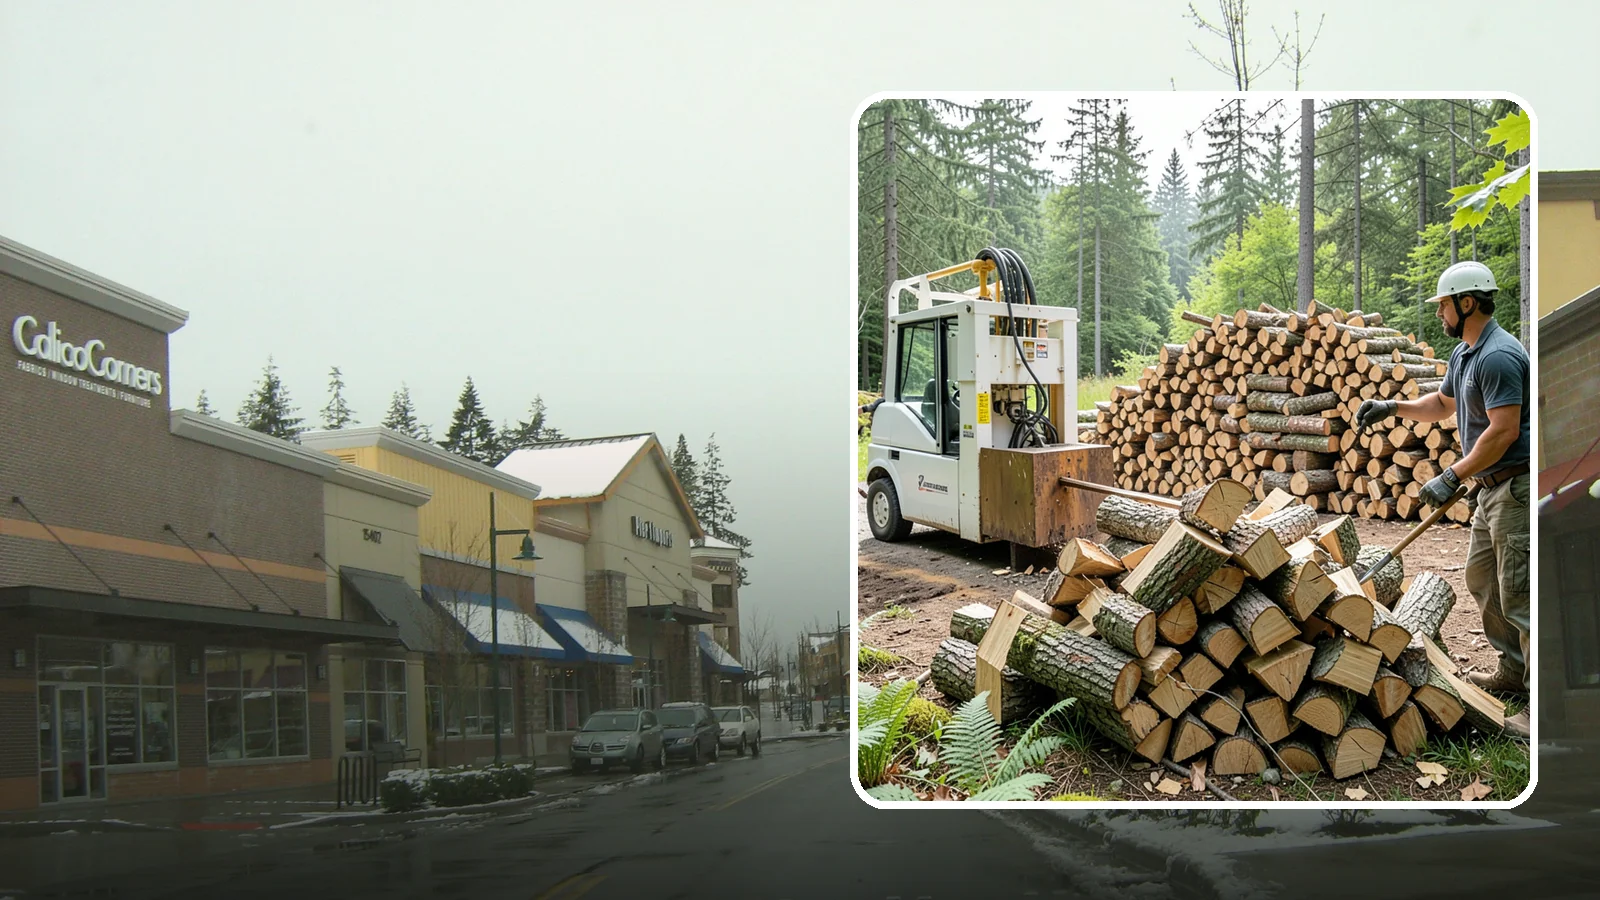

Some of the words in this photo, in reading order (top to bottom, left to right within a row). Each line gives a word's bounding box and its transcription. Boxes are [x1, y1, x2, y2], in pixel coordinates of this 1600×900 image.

[16, 359, 47, 377] FABRICS
[51, 370, 78, 387] WINDOW
[78, 378, 117, 398] TREATMENTS
